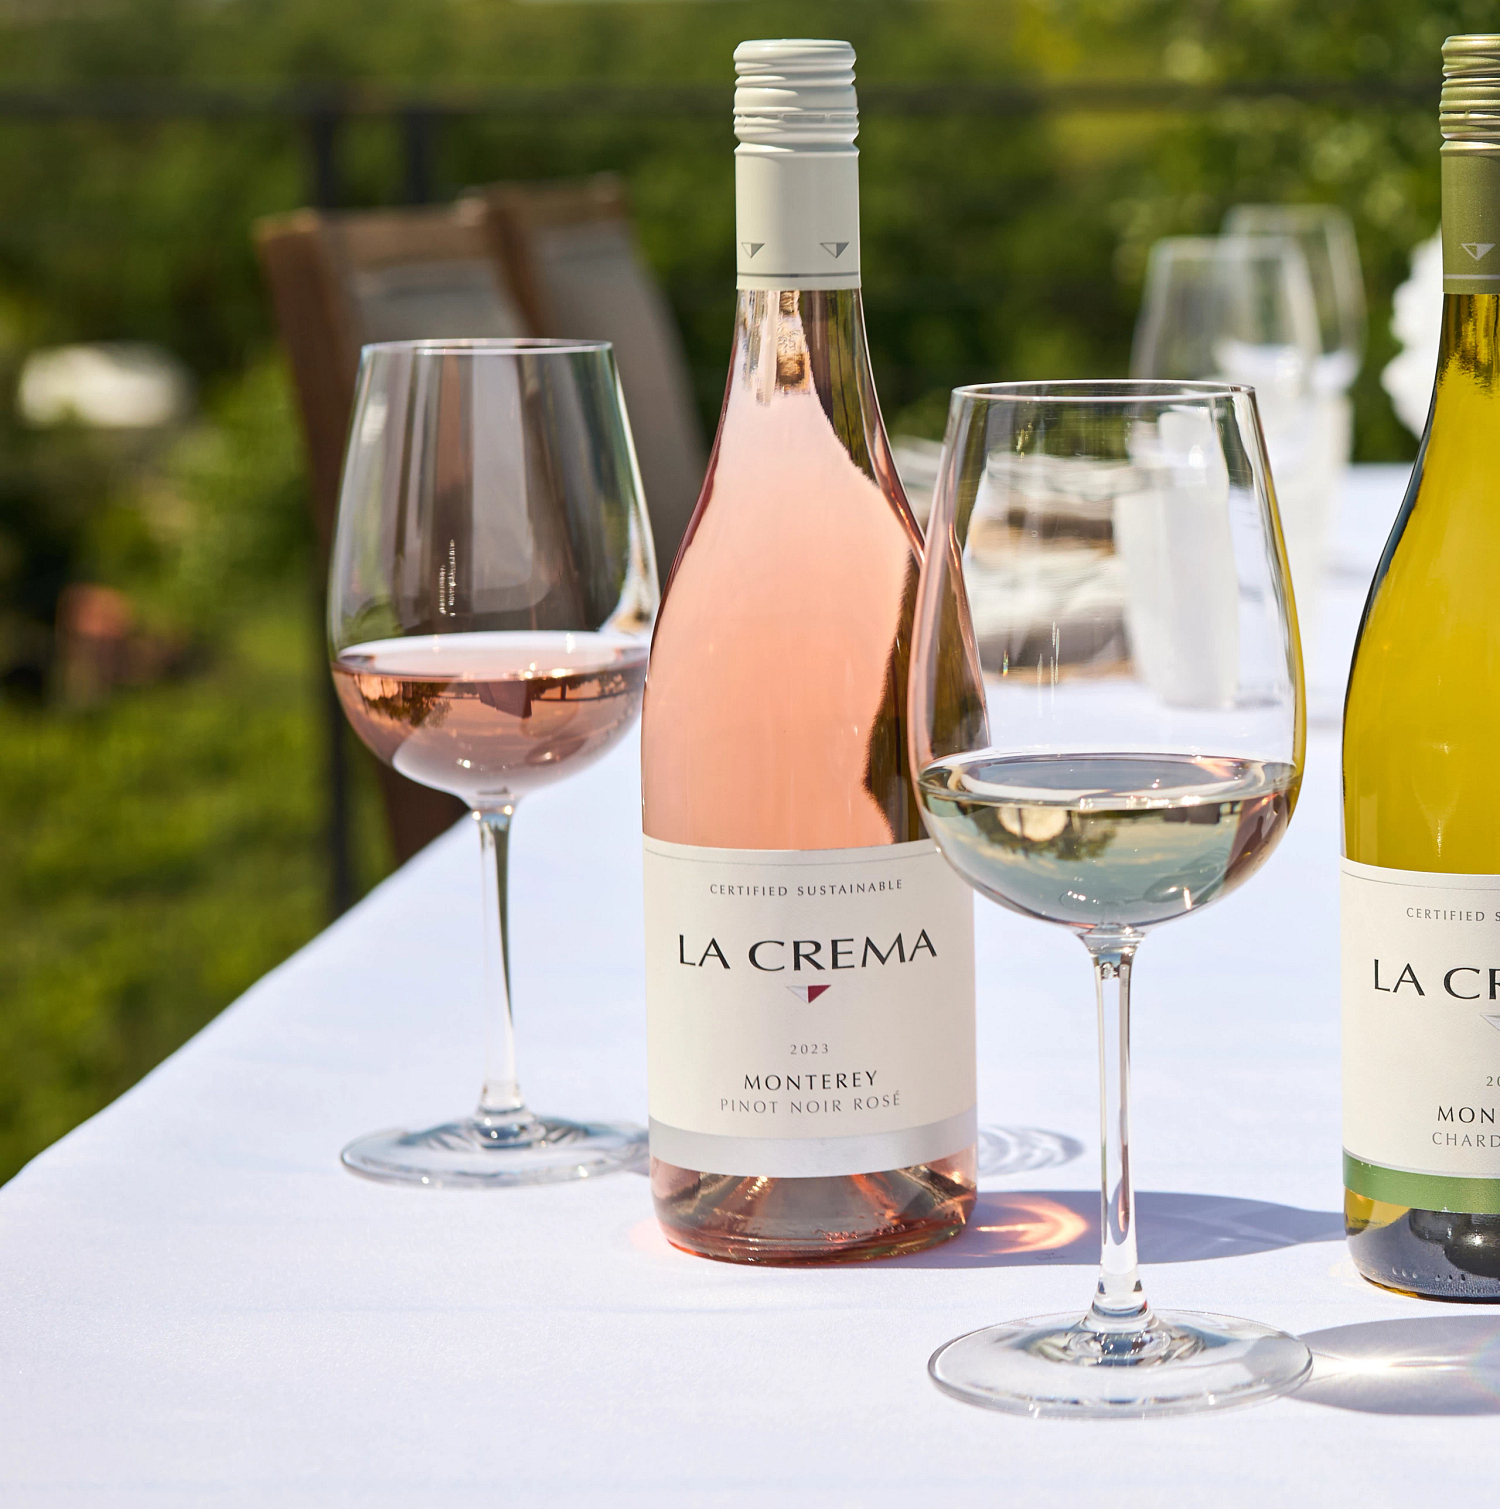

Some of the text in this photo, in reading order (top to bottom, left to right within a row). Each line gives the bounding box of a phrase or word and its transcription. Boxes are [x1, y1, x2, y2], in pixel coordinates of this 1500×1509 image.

[709, 878, 902, 897] CERTIFIED SUSTAINABLE
[1406, 907, 1485, 922] CERTIFIED
[678, 928, 938, 972] LA CREMA
[1373, 958, 1426, 997] LA
[790, 1043, 829, 1056] 2023
[744, 1070, 877, 1091] MONTEREY
[720, 1089, 900, 1114] PINOT NOIR ROSÉ
